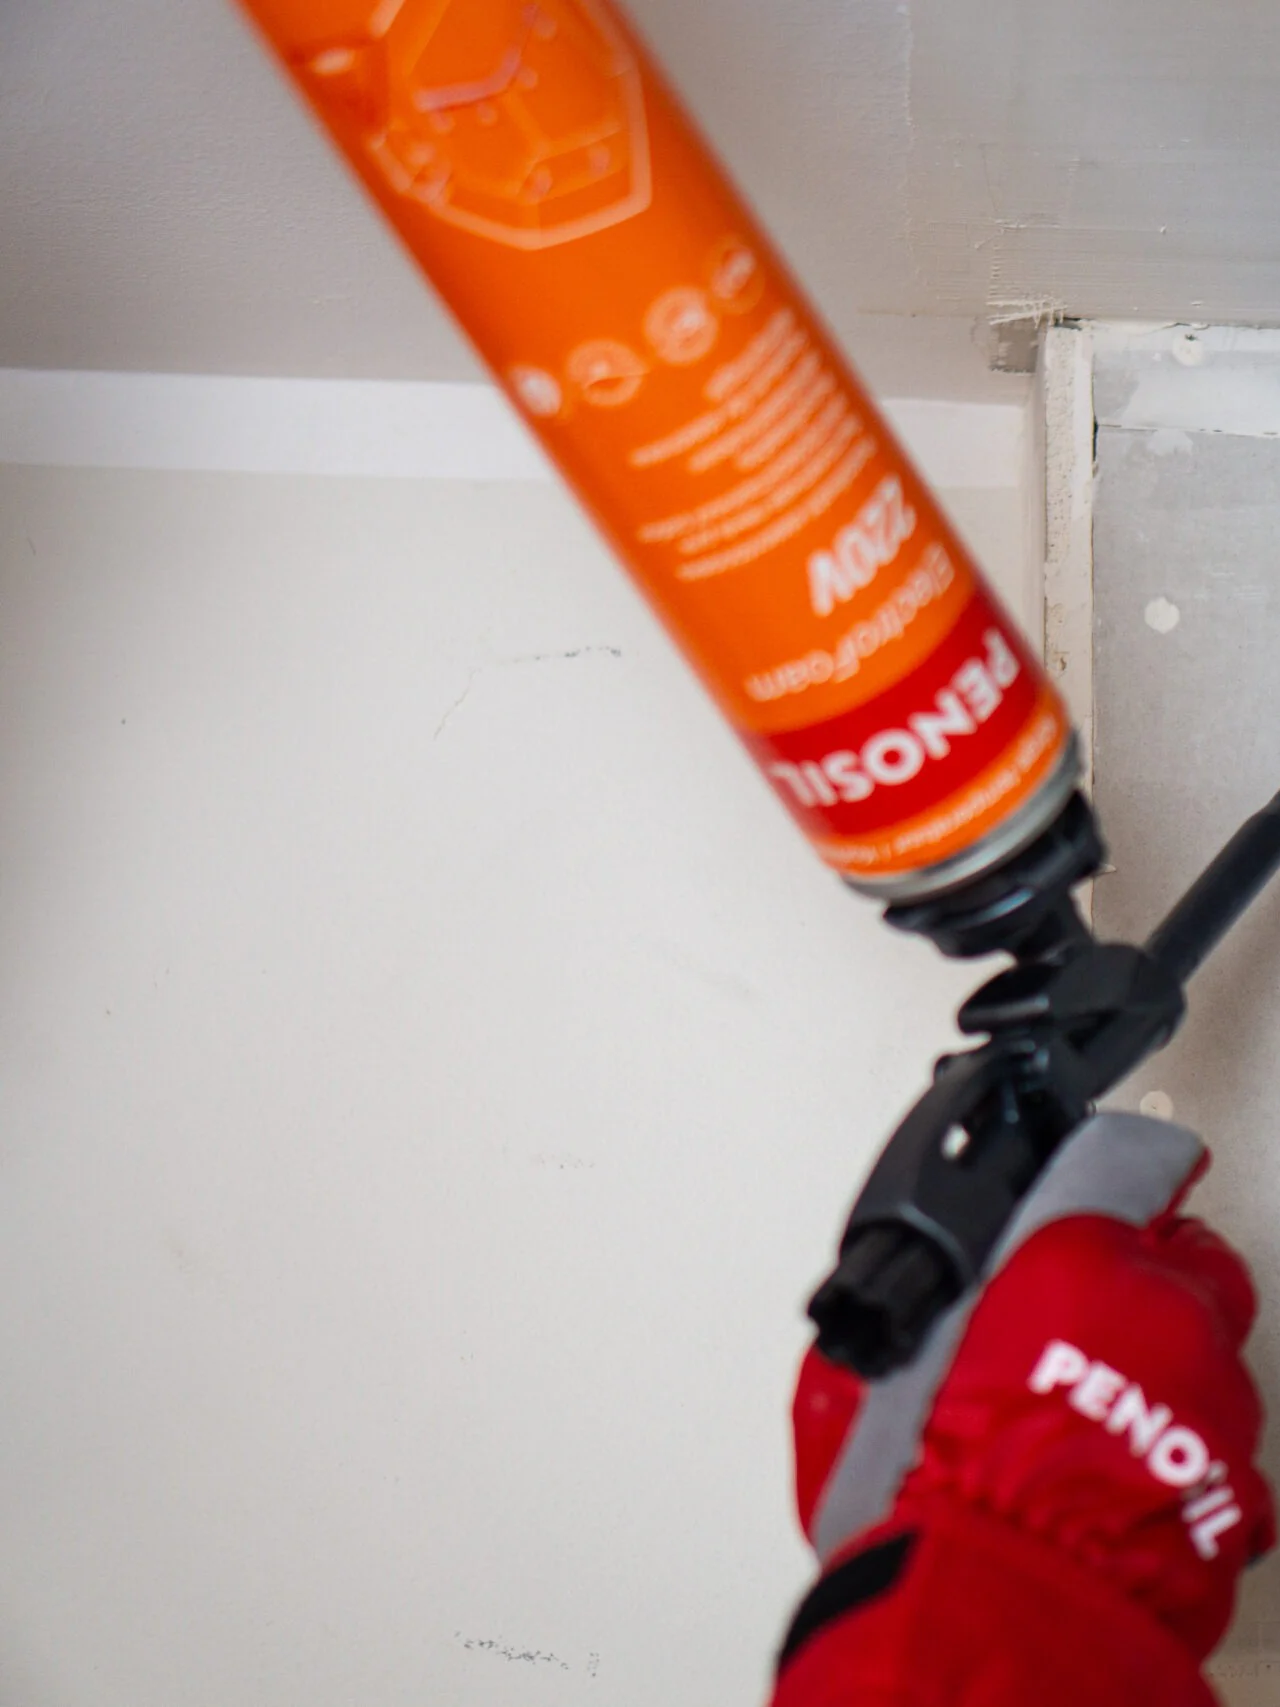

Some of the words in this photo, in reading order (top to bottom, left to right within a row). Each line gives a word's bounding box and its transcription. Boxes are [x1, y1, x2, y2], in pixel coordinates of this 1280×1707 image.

[744, 542, 955, 701] ElectroFoam
[807, 473, 917, 618] 220V
[770, 628, 1020, 806] PENOSIL
